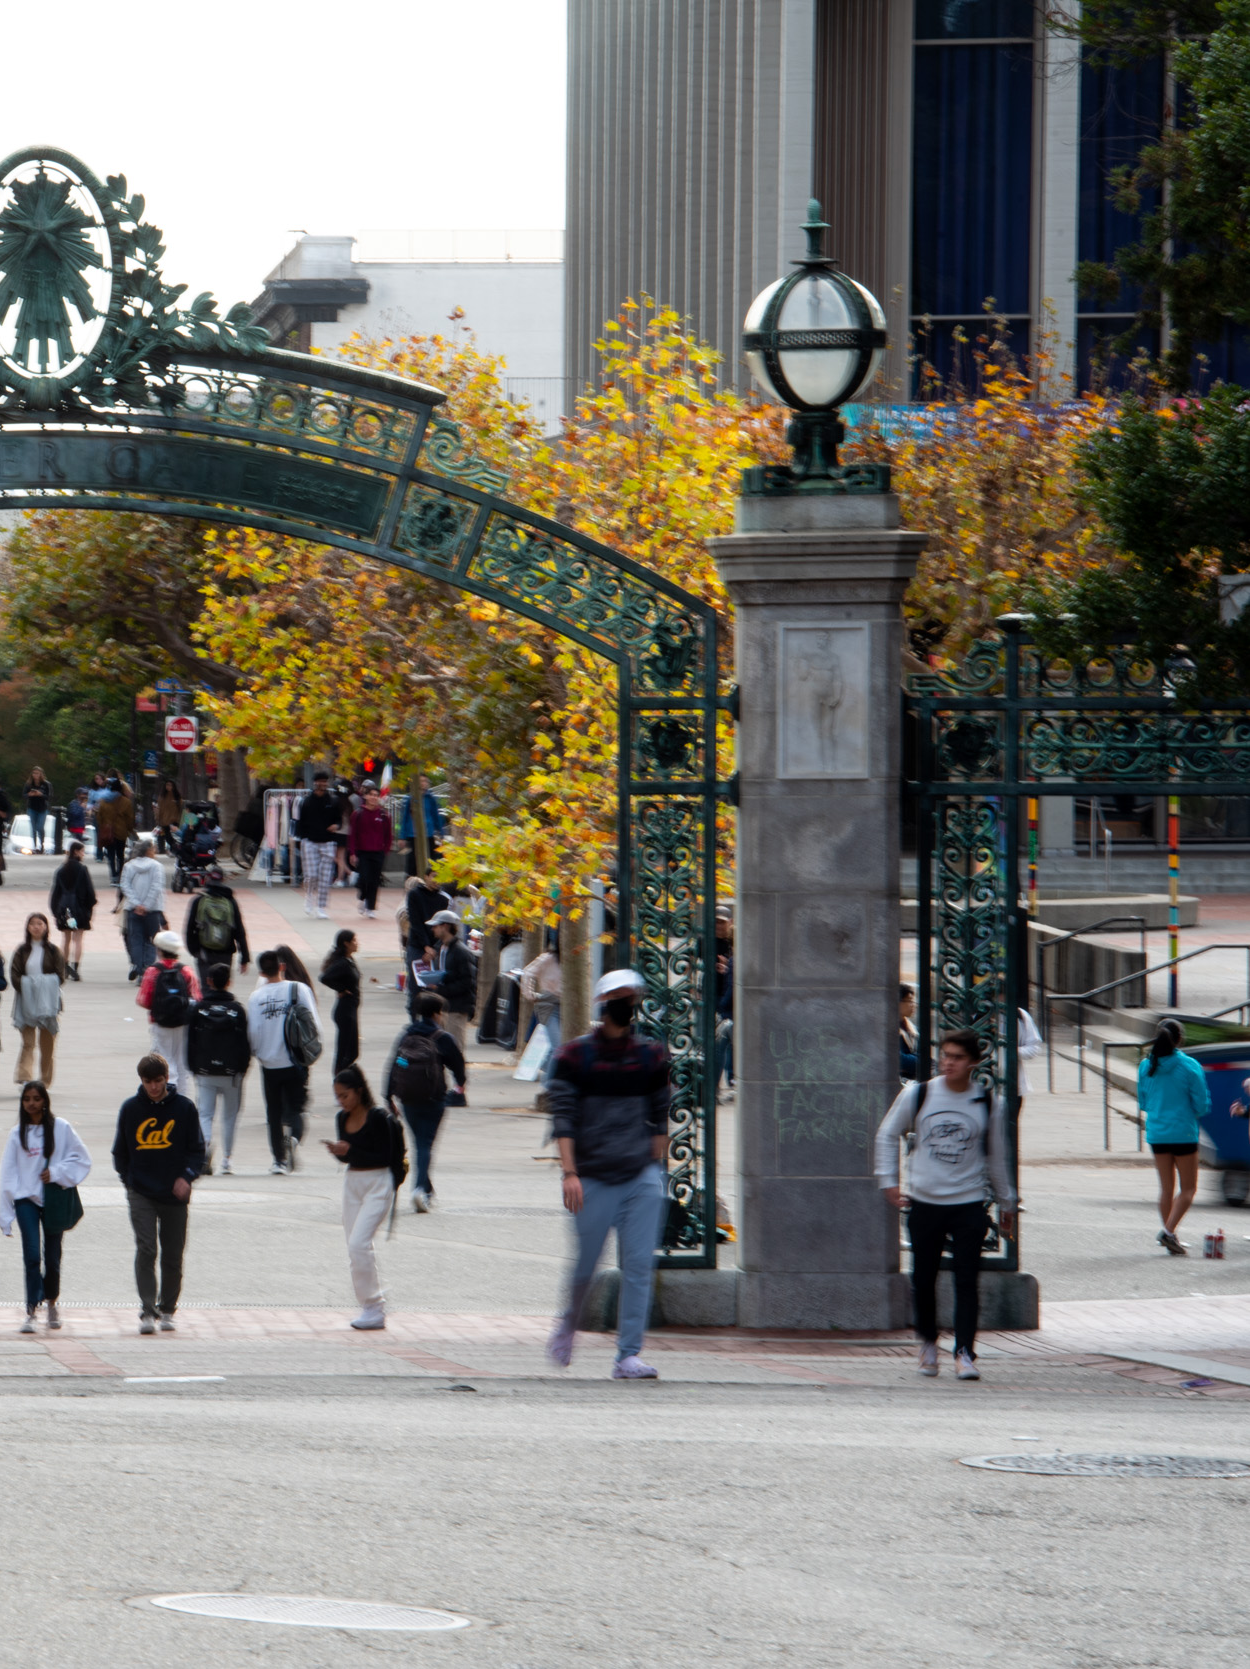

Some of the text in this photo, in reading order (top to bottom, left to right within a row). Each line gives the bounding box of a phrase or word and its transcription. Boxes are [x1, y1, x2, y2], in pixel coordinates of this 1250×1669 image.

[104, 441, 264, 496] GATE
[171, 738, 191, 746] ENTER
[135, 1117, 176, 1150] Cal
